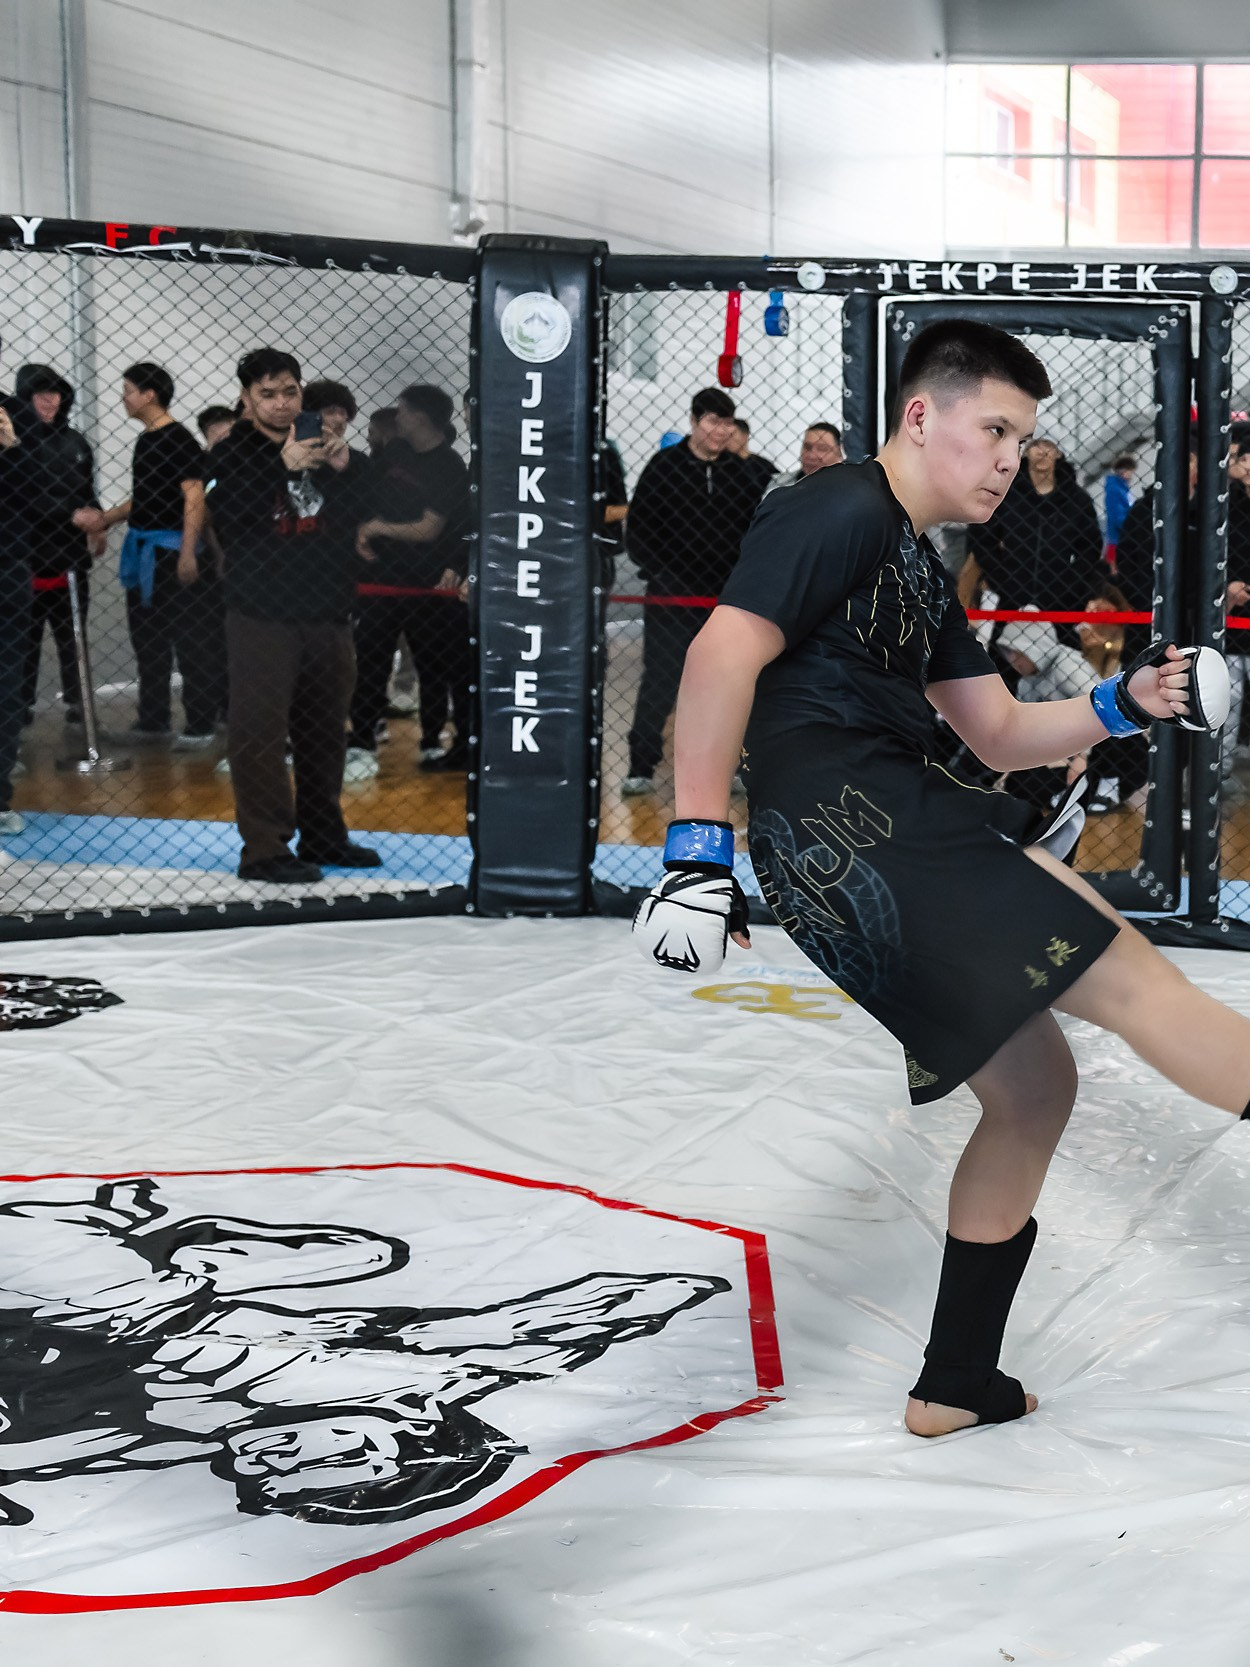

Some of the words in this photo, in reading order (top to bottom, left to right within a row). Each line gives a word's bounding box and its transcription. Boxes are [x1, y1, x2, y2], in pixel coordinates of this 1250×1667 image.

[877, 262, 1031, 291] JEKPE
[1070, 264, 1158, 292] JEK
[517, 371, 547, 598] JEKPE
[511, 625, 541, 753] JEK
